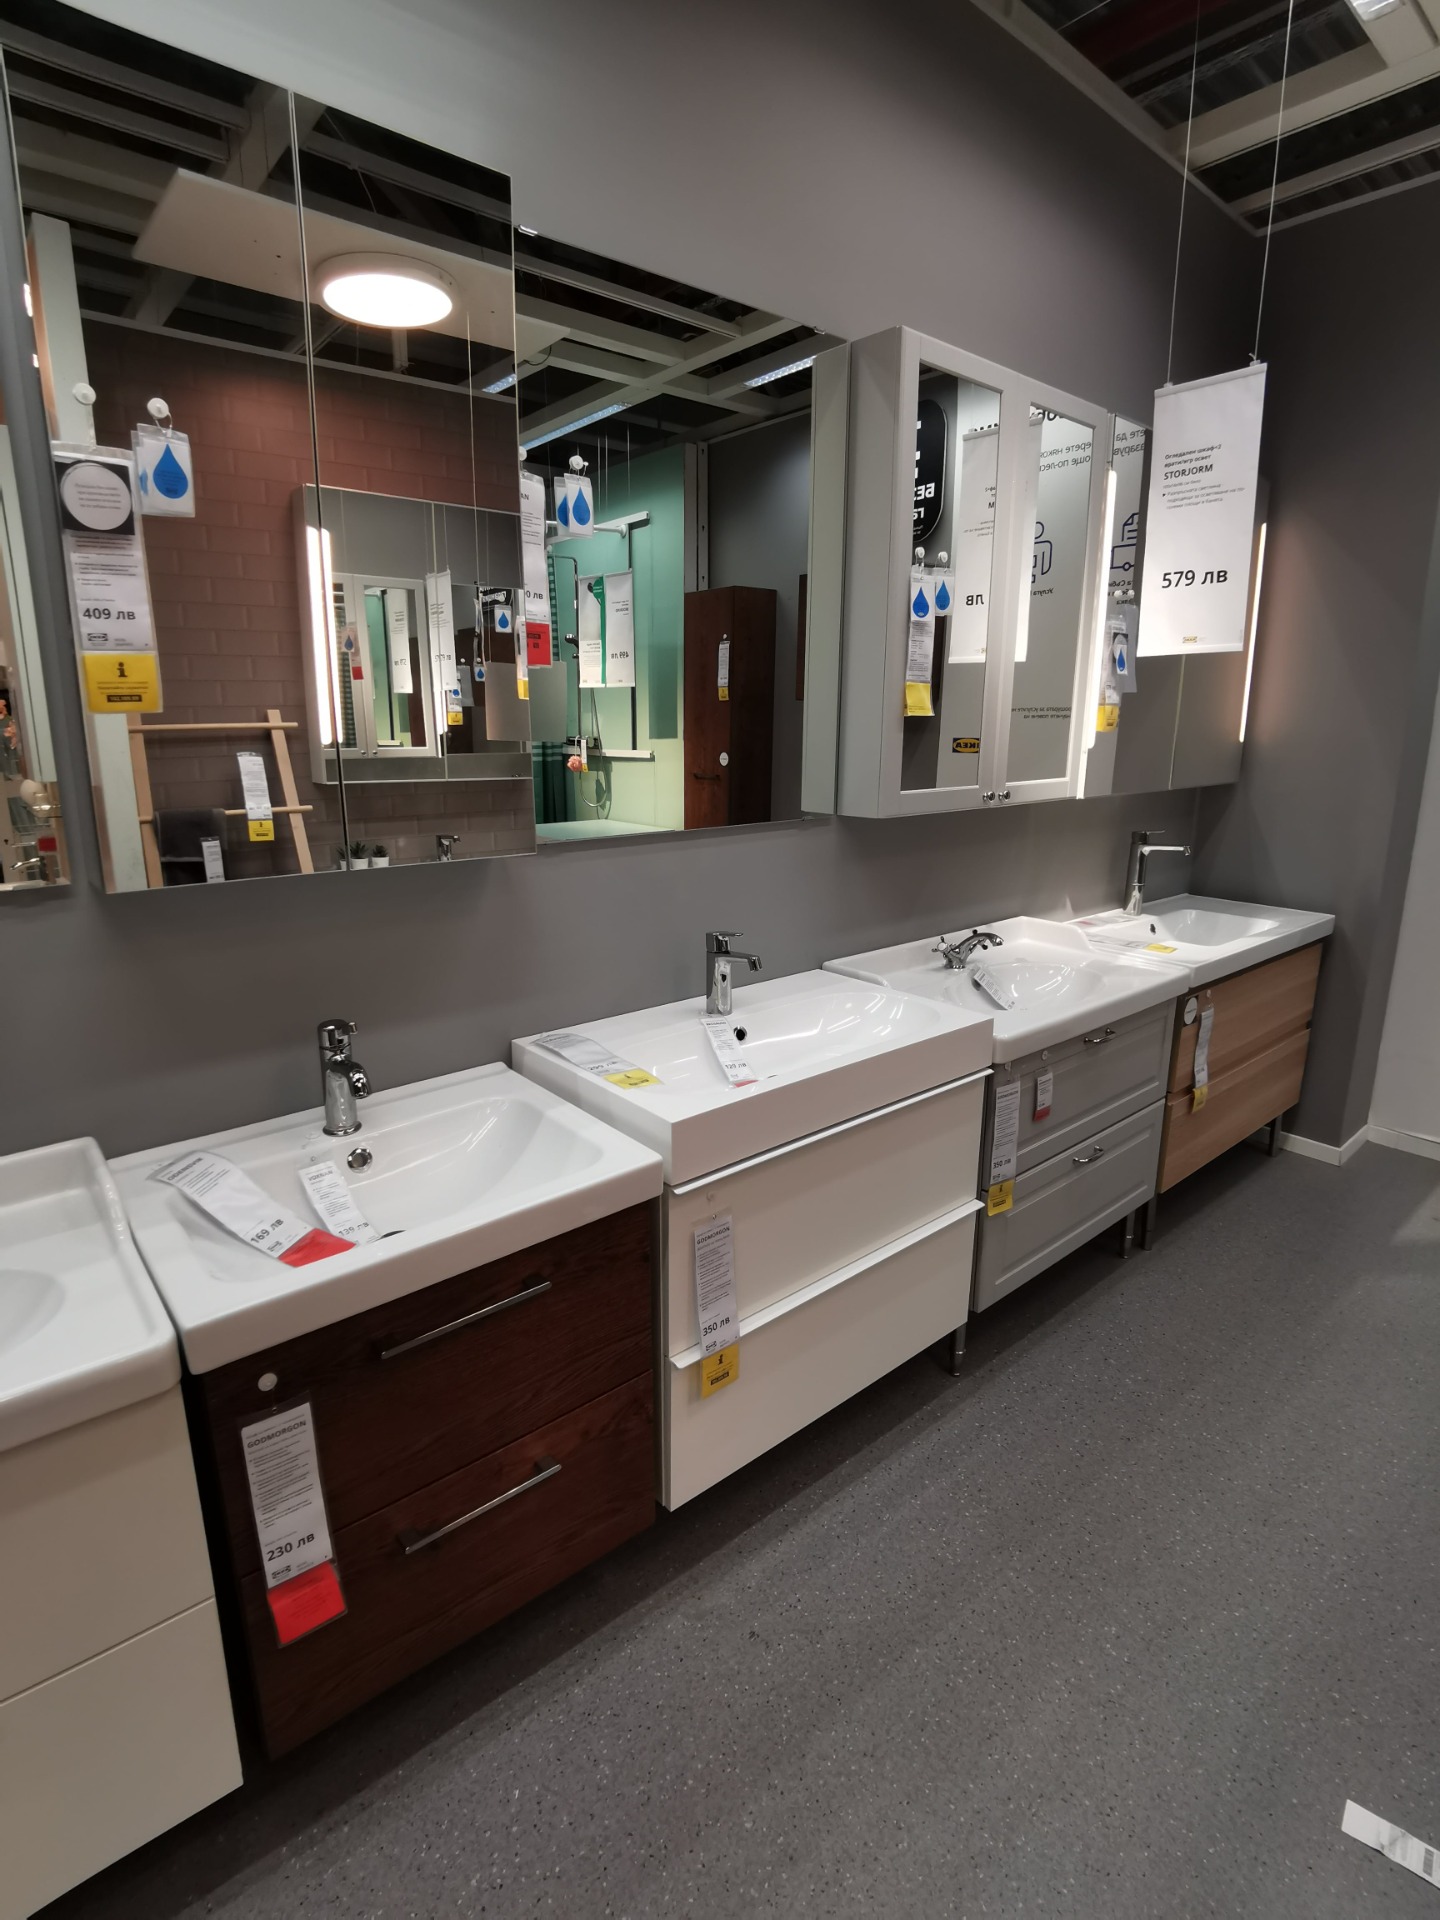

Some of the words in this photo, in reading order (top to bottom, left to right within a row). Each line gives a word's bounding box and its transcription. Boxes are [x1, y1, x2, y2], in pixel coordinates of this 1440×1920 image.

[1164, 464, 1213, 480] STORJORM
[1162, 570, 1195, 588] 579
[1201, 570, 1228, 584] лв
[83, 608, 111, 620] 409
[116, 611, 136, 620] лв
[251, 1229, 270, 1243] 169
[270, 1219, 284, 1231] лв
[338, 1227, 355, 1236] 139
[702, 1322, 718, 1336] 350
[720, 1317, 730, 1328] лв
[247, 1420, 306, 1448] GODMORGON
[267, 1542, 292, 1562] 230
[297, 1533, 315, 1548] лв
